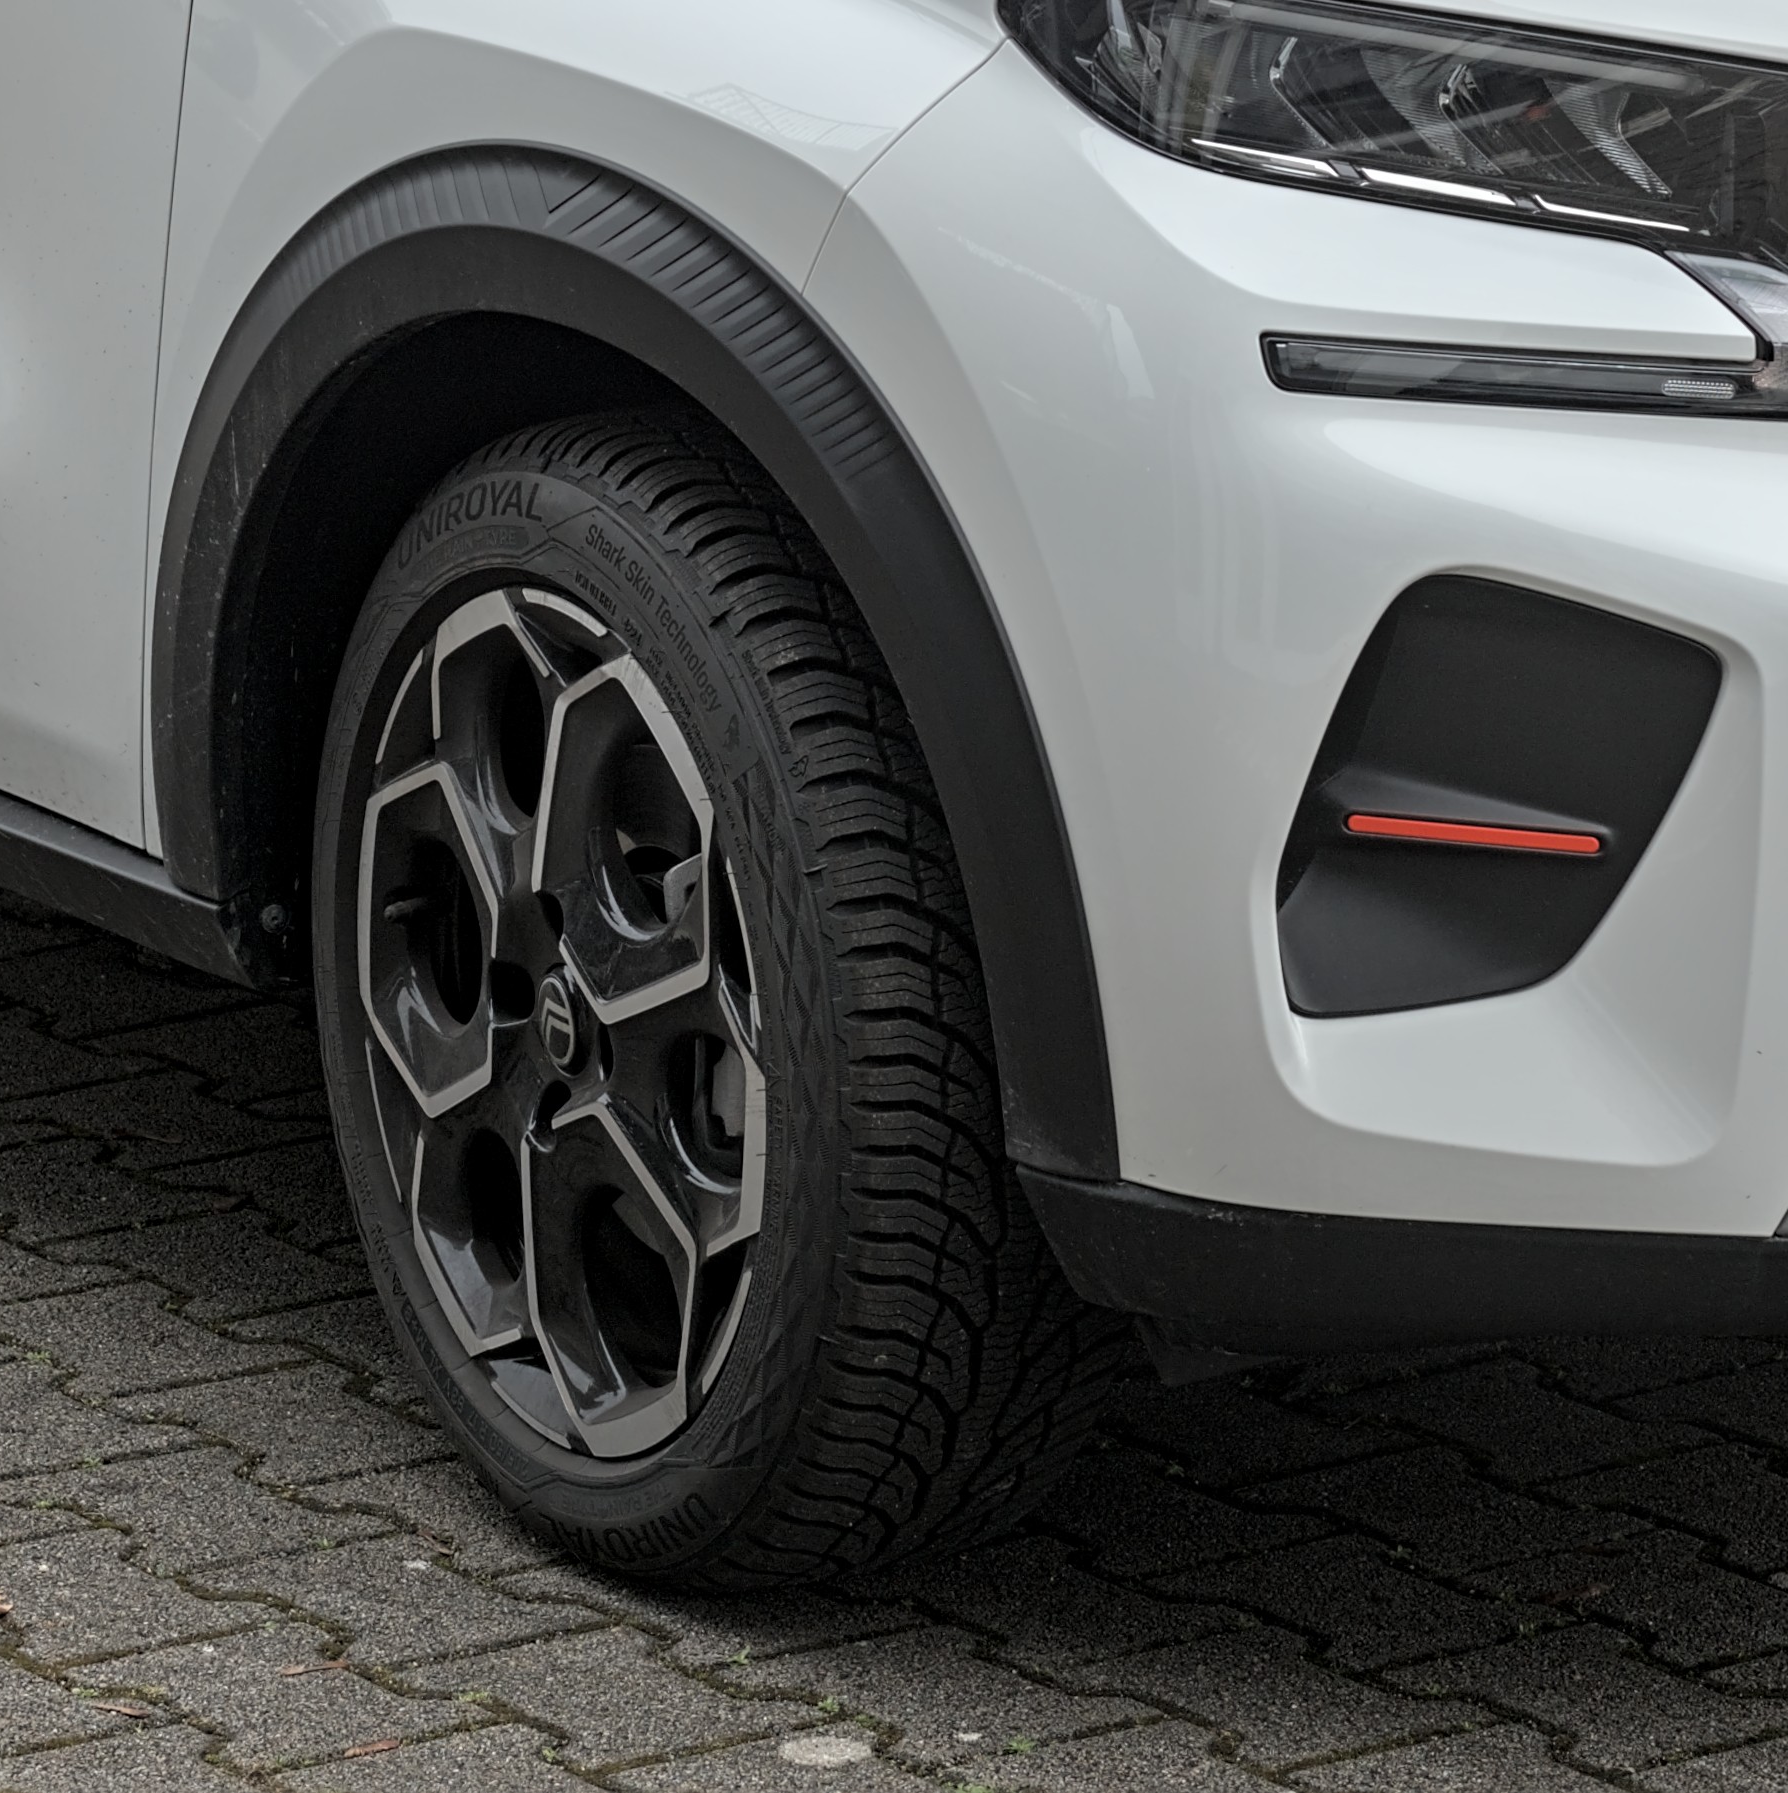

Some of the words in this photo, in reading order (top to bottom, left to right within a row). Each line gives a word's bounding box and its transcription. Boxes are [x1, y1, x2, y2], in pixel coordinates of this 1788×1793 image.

[396, 479, 543, 570] UNIROYAL
[585, 523, 625, 573] Shark
[624, 560, 656, 606] Skin
[653, 595, 723, 712] Technology
[538, 1493, 712, 1563] UNIROYAL
